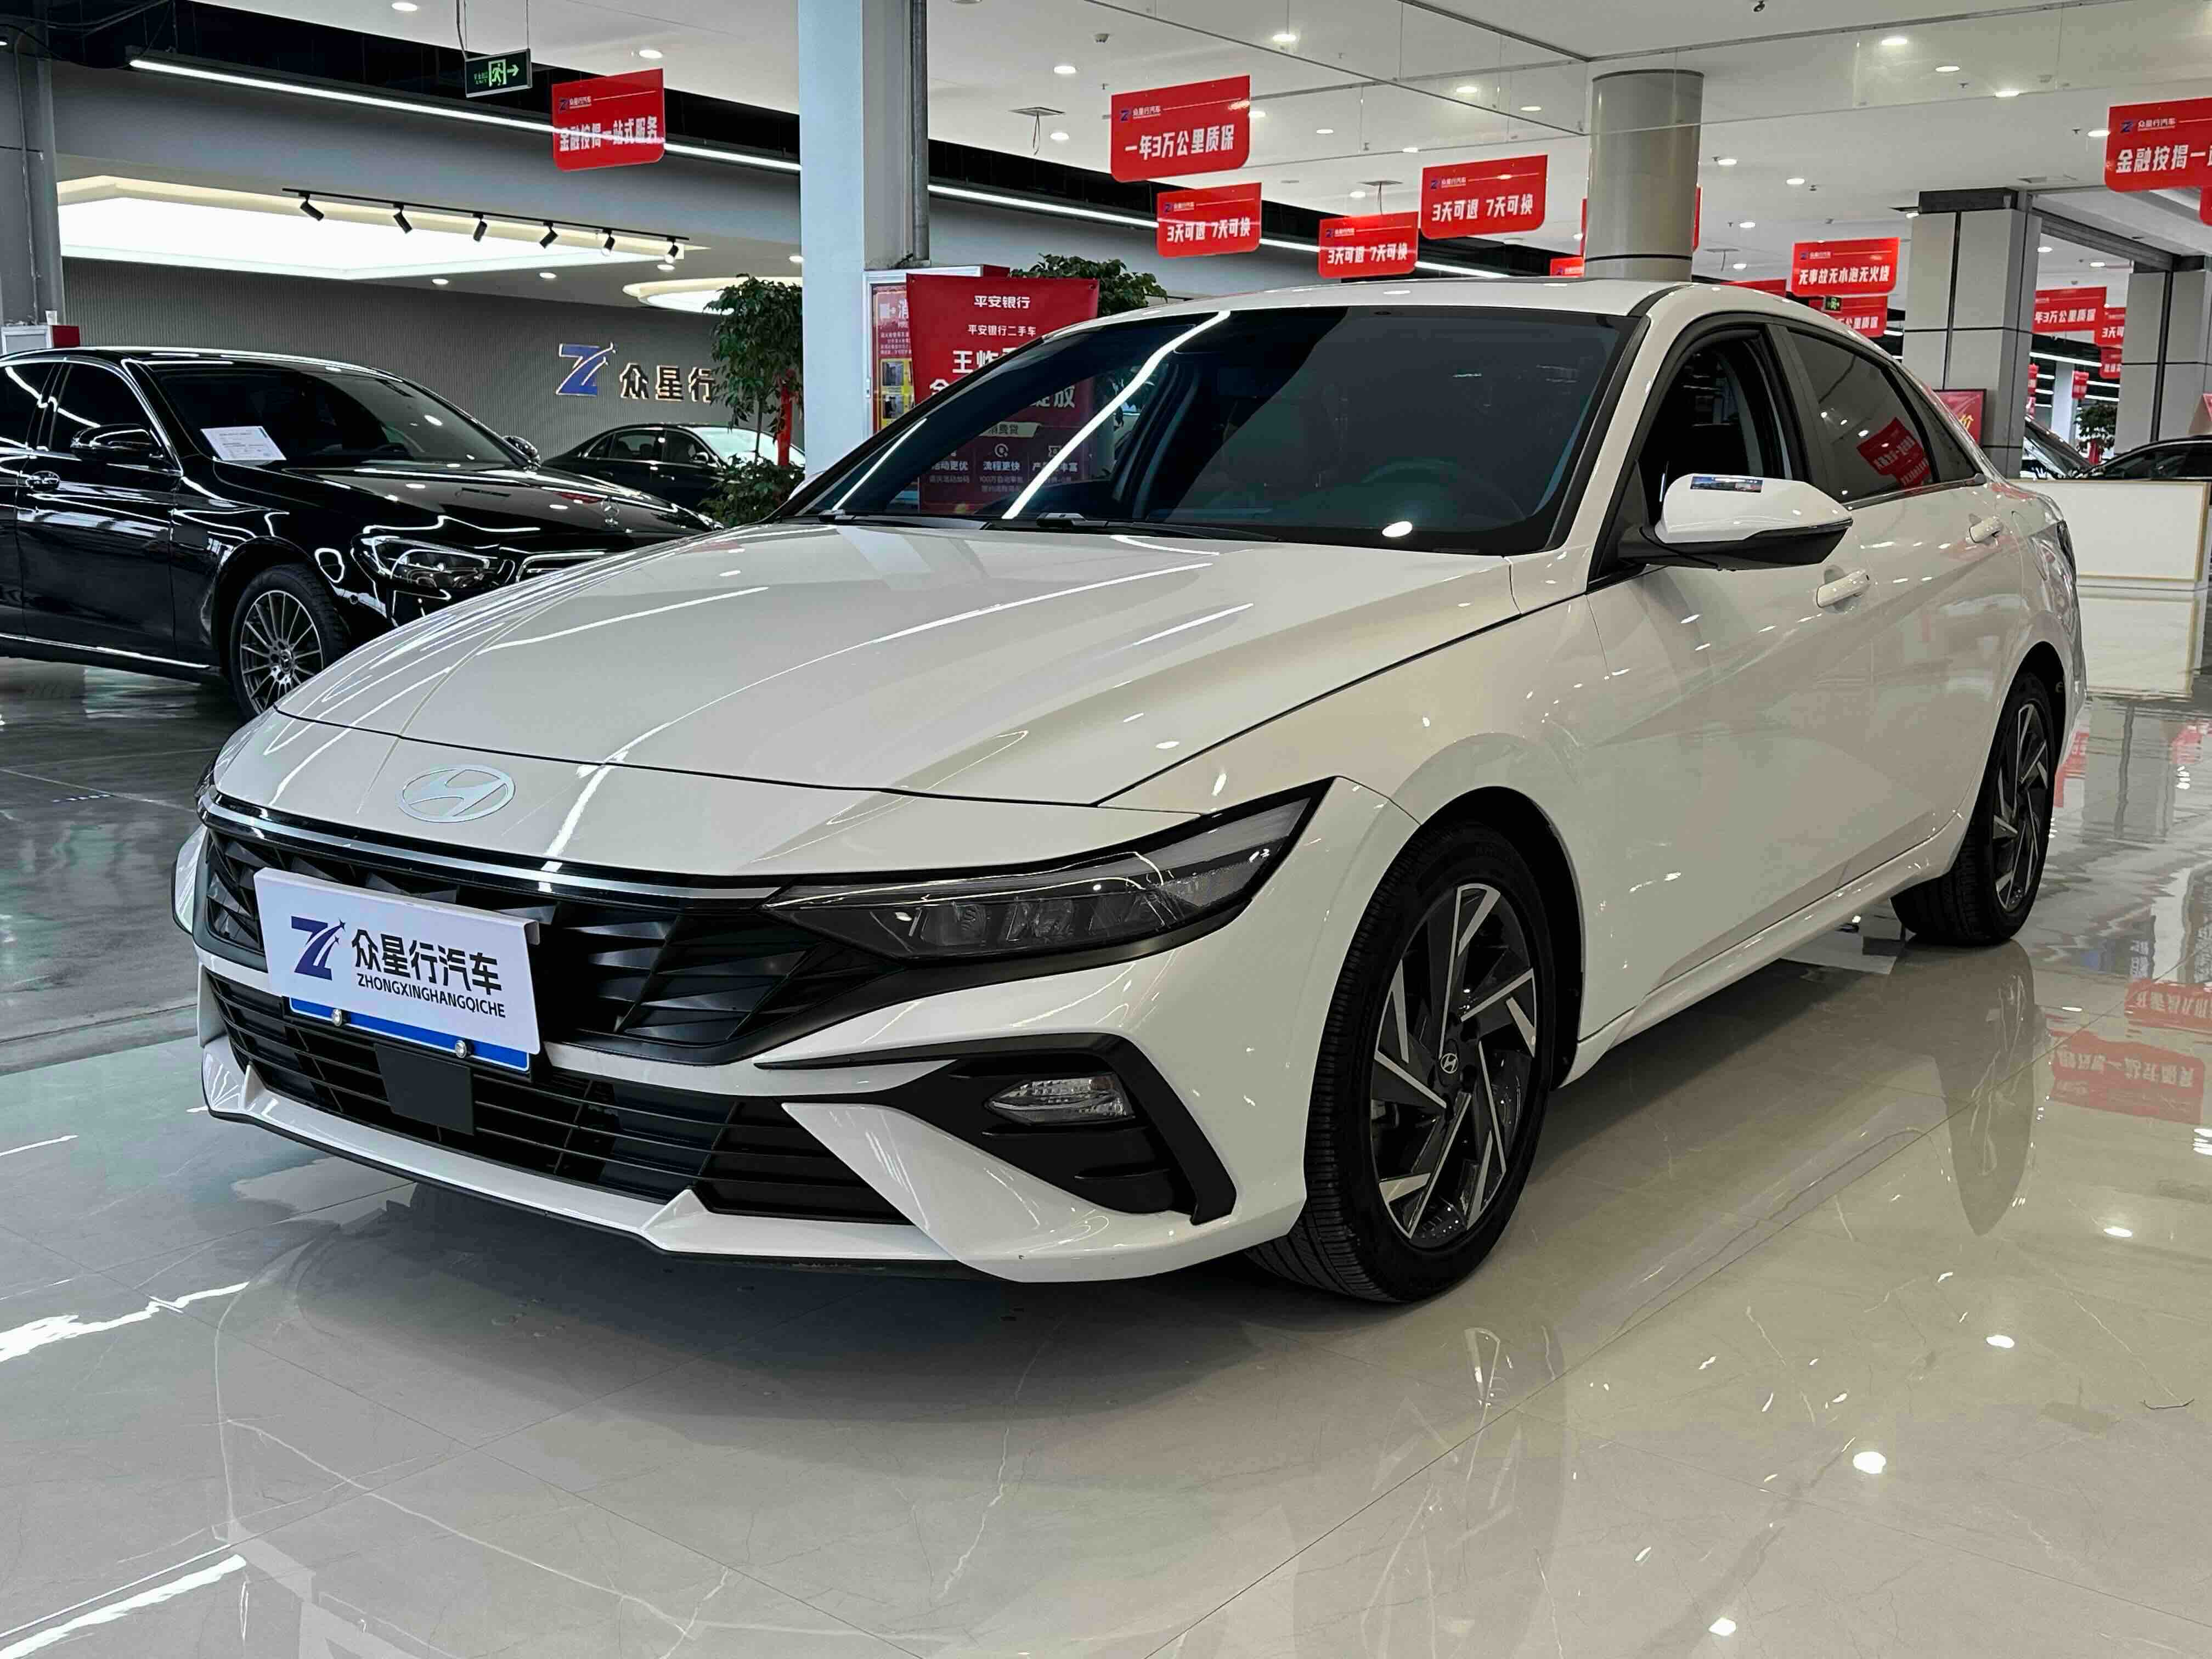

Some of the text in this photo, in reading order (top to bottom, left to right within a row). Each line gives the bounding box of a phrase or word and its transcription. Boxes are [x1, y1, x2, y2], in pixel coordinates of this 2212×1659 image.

[1125, 124, 1235, 160] 一年3万公里质保
[1431, 193, 1533, 222] 3天可退 7天可换
[1166, 217, 1251, 243] 3天可退 7天可换
[1327, 242, 1408, 265] 3天可退 7天可换
[1798, 265, 1891, 285] 无事故无水泡无火烧
[974, 295, 1031, 309] 平安银行
[968, 324, 1036, 337] 平安银行二手车
[952, 347, 1018, 374] 王炸
[619, 363, 715, 403] 众星行
[351, 928, 503, 996] 众星行汽车
[357, 973, 506, 1018] ZHONGXINGHANGQICHE
